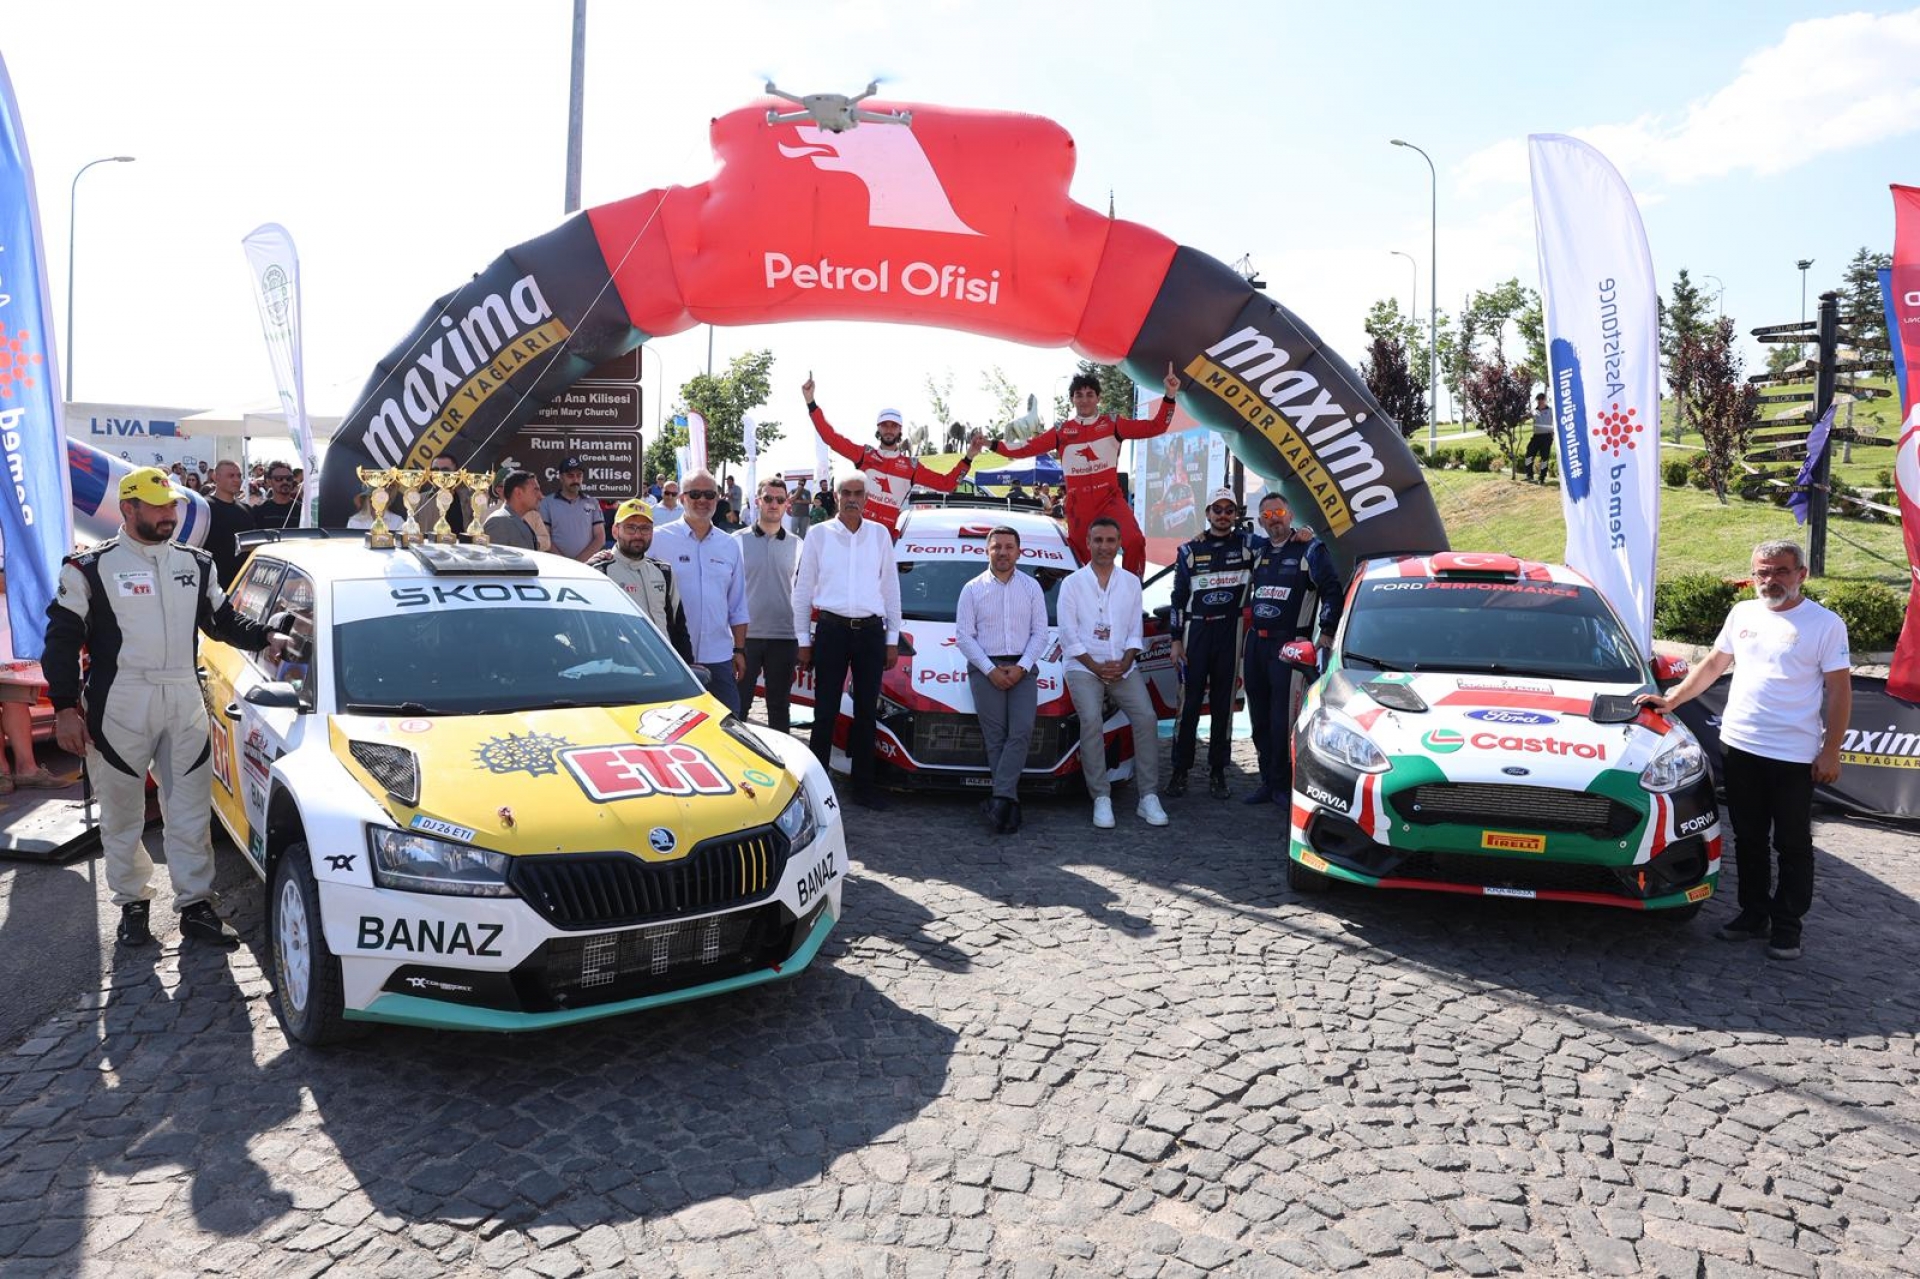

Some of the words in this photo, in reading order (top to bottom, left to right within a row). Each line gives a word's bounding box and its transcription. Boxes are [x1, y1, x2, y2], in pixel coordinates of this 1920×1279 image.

[764, 251, 888, 293] Petrol
[901, 261, 1000, 305] Ofisi
[362, 274, 552, 469] maxima
[408, 407, 464, 469] MOTOR
[464, 330, 551, 403] YAĞLARI
[565, 393, 586, 403] Ana
[589, 393, 631, 404] Kilisesi
[560, 408, 582, 417] Mary
[584, 408, 618, 418] Church)
[1205, 325, 1398, 523] maxima
[530, 438, 565, 449] Rum
[569, 439, 632, 451] Hamamı
[1205, 371, 1276, 431] MOTOR
[1278, 432, 1343, 519] YAĞLARI
[579, 454, 607, 463] (Greek
[609, 455, 632, 463] Bath)
[588, 468, 632, 480] Kilise
[599, 484, 632, 492] Church)
[905, 544, 955, 554] Team
[1021, 548, 1063, 560] Ofisi
[1373, 582, 1423, 592] FORD
[1425, 582, 1579, 598] PERFORMANCE
[1282, 645, 1303, 660] NGK
[919, 669, 968, 685] Petr
[1470, 732, 1606, 760] Castrol
[1306, 785, 1348, 811] FORVIA
[422, 820, 437, 829] DJ
[437, 824, 450, 834] 26
[452, 829, 471, 839] ETI
[1487, 834, 1540, 849] PIRELLI
[797, 852, 838, 906] BANAZ
[356, 915, 504, 957] BANAZ
